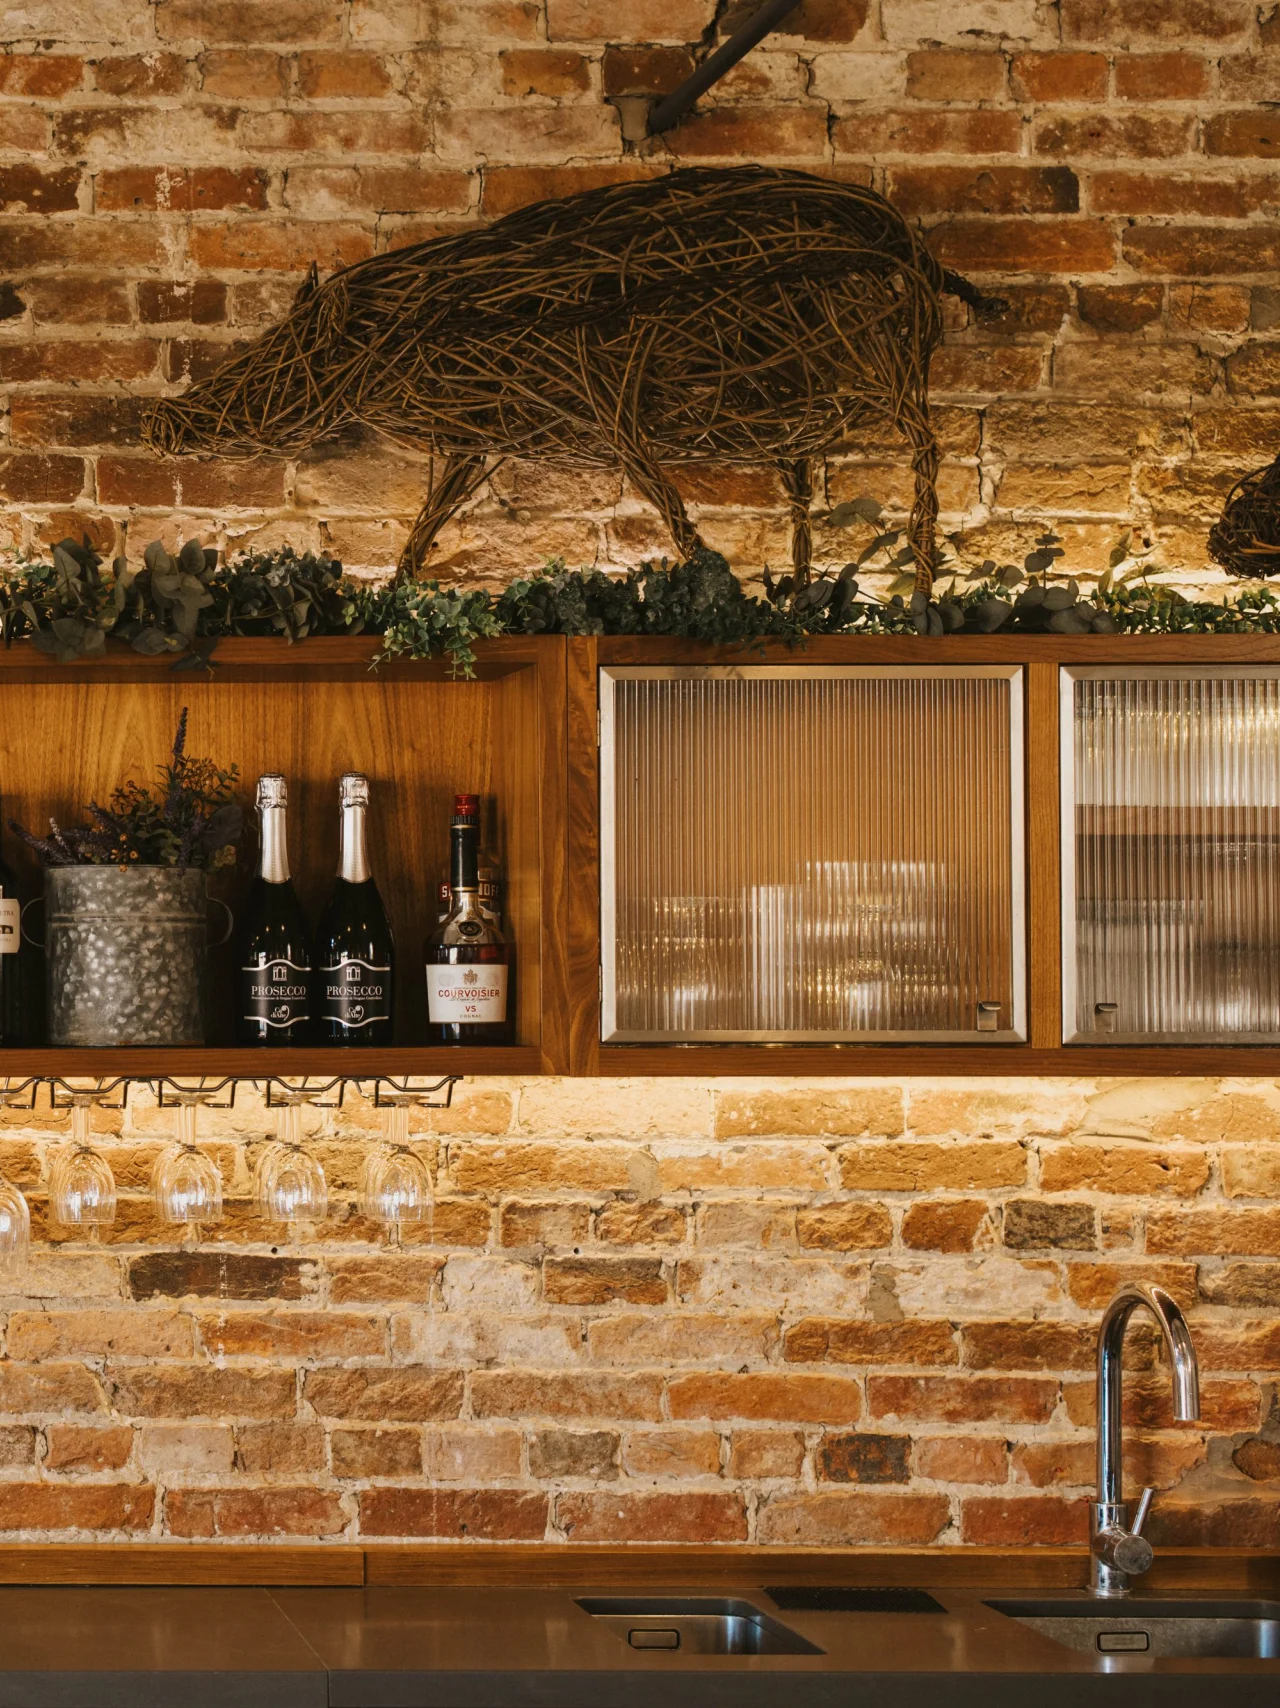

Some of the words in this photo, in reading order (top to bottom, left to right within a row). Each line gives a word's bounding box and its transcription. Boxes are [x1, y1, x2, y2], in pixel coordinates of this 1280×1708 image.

[251, 986, 306, 995] PROSECCO
[327, 986, 382, 995] PROSECCO
[438, 990, 500, 998] COURVOISIER
